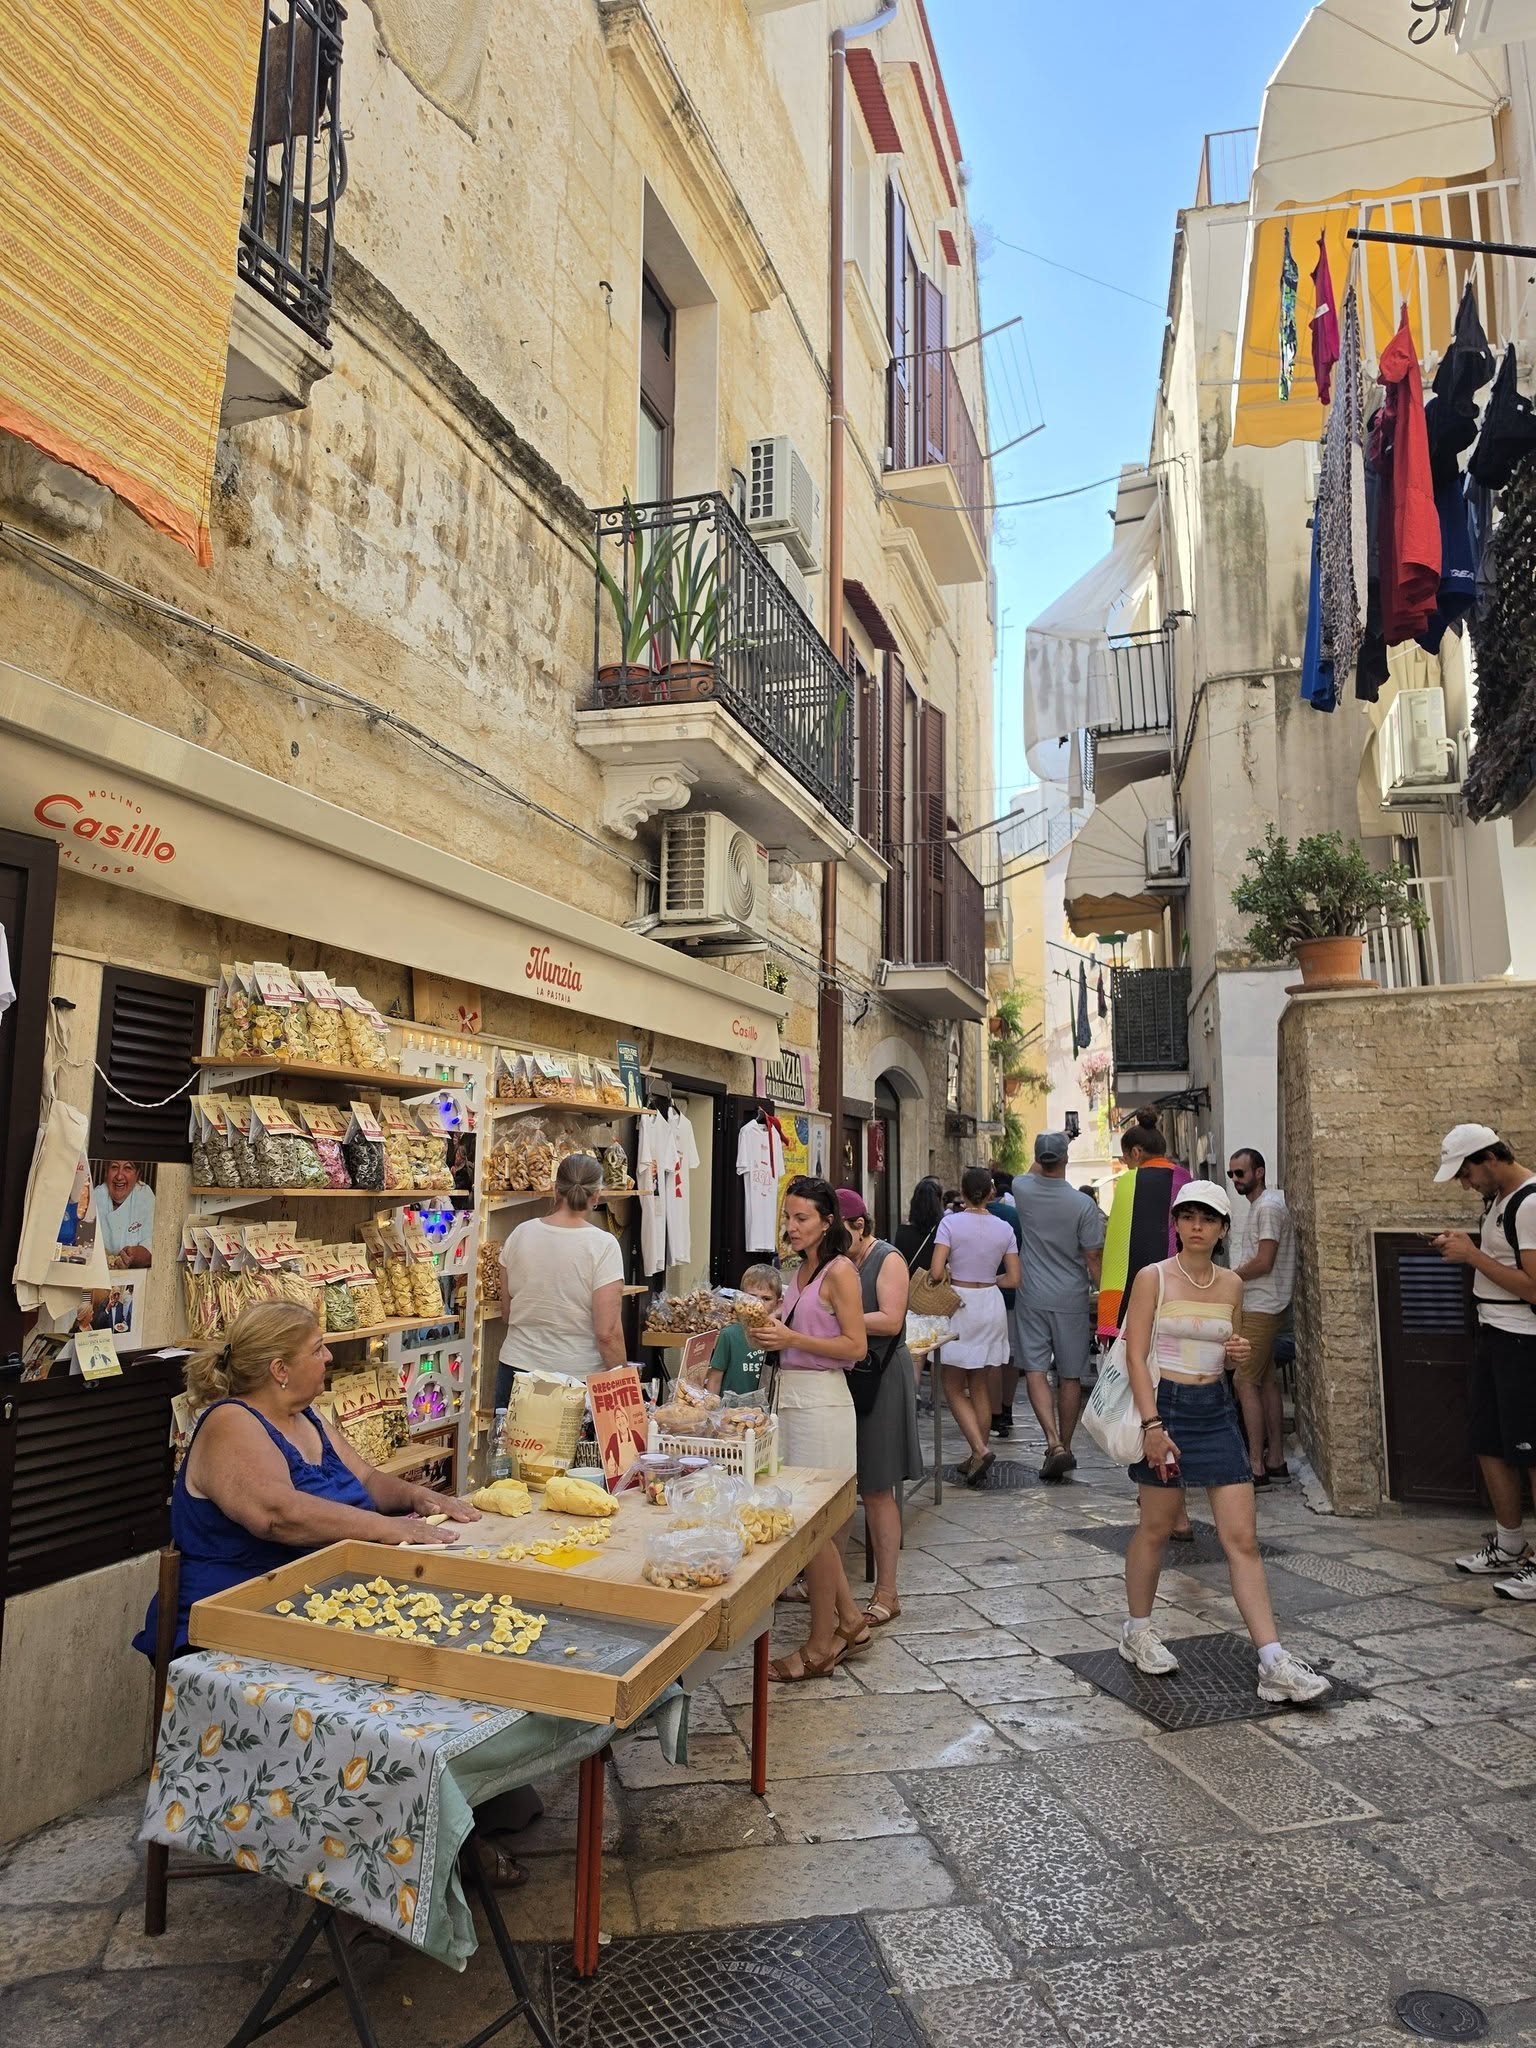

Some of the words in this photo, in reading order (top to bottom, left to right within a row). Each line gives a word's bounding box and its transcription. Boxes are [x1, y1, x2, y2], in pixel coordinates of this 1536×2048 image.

[88, 790, 142, 814] MOLINO
[34, 794, 176, 863] Casillo
[57, 841, 80, 864] DAL
[91, 863, 135, 874] 1958
[525, 946, 583, 992] Nunzia
[536, 986, 544, 996] LA
[547, 989, 571, 1003] PASTAIA
[732, 1019, 758, 1041] Casillo
[594, 1386, 640, 1413] FRITTE
